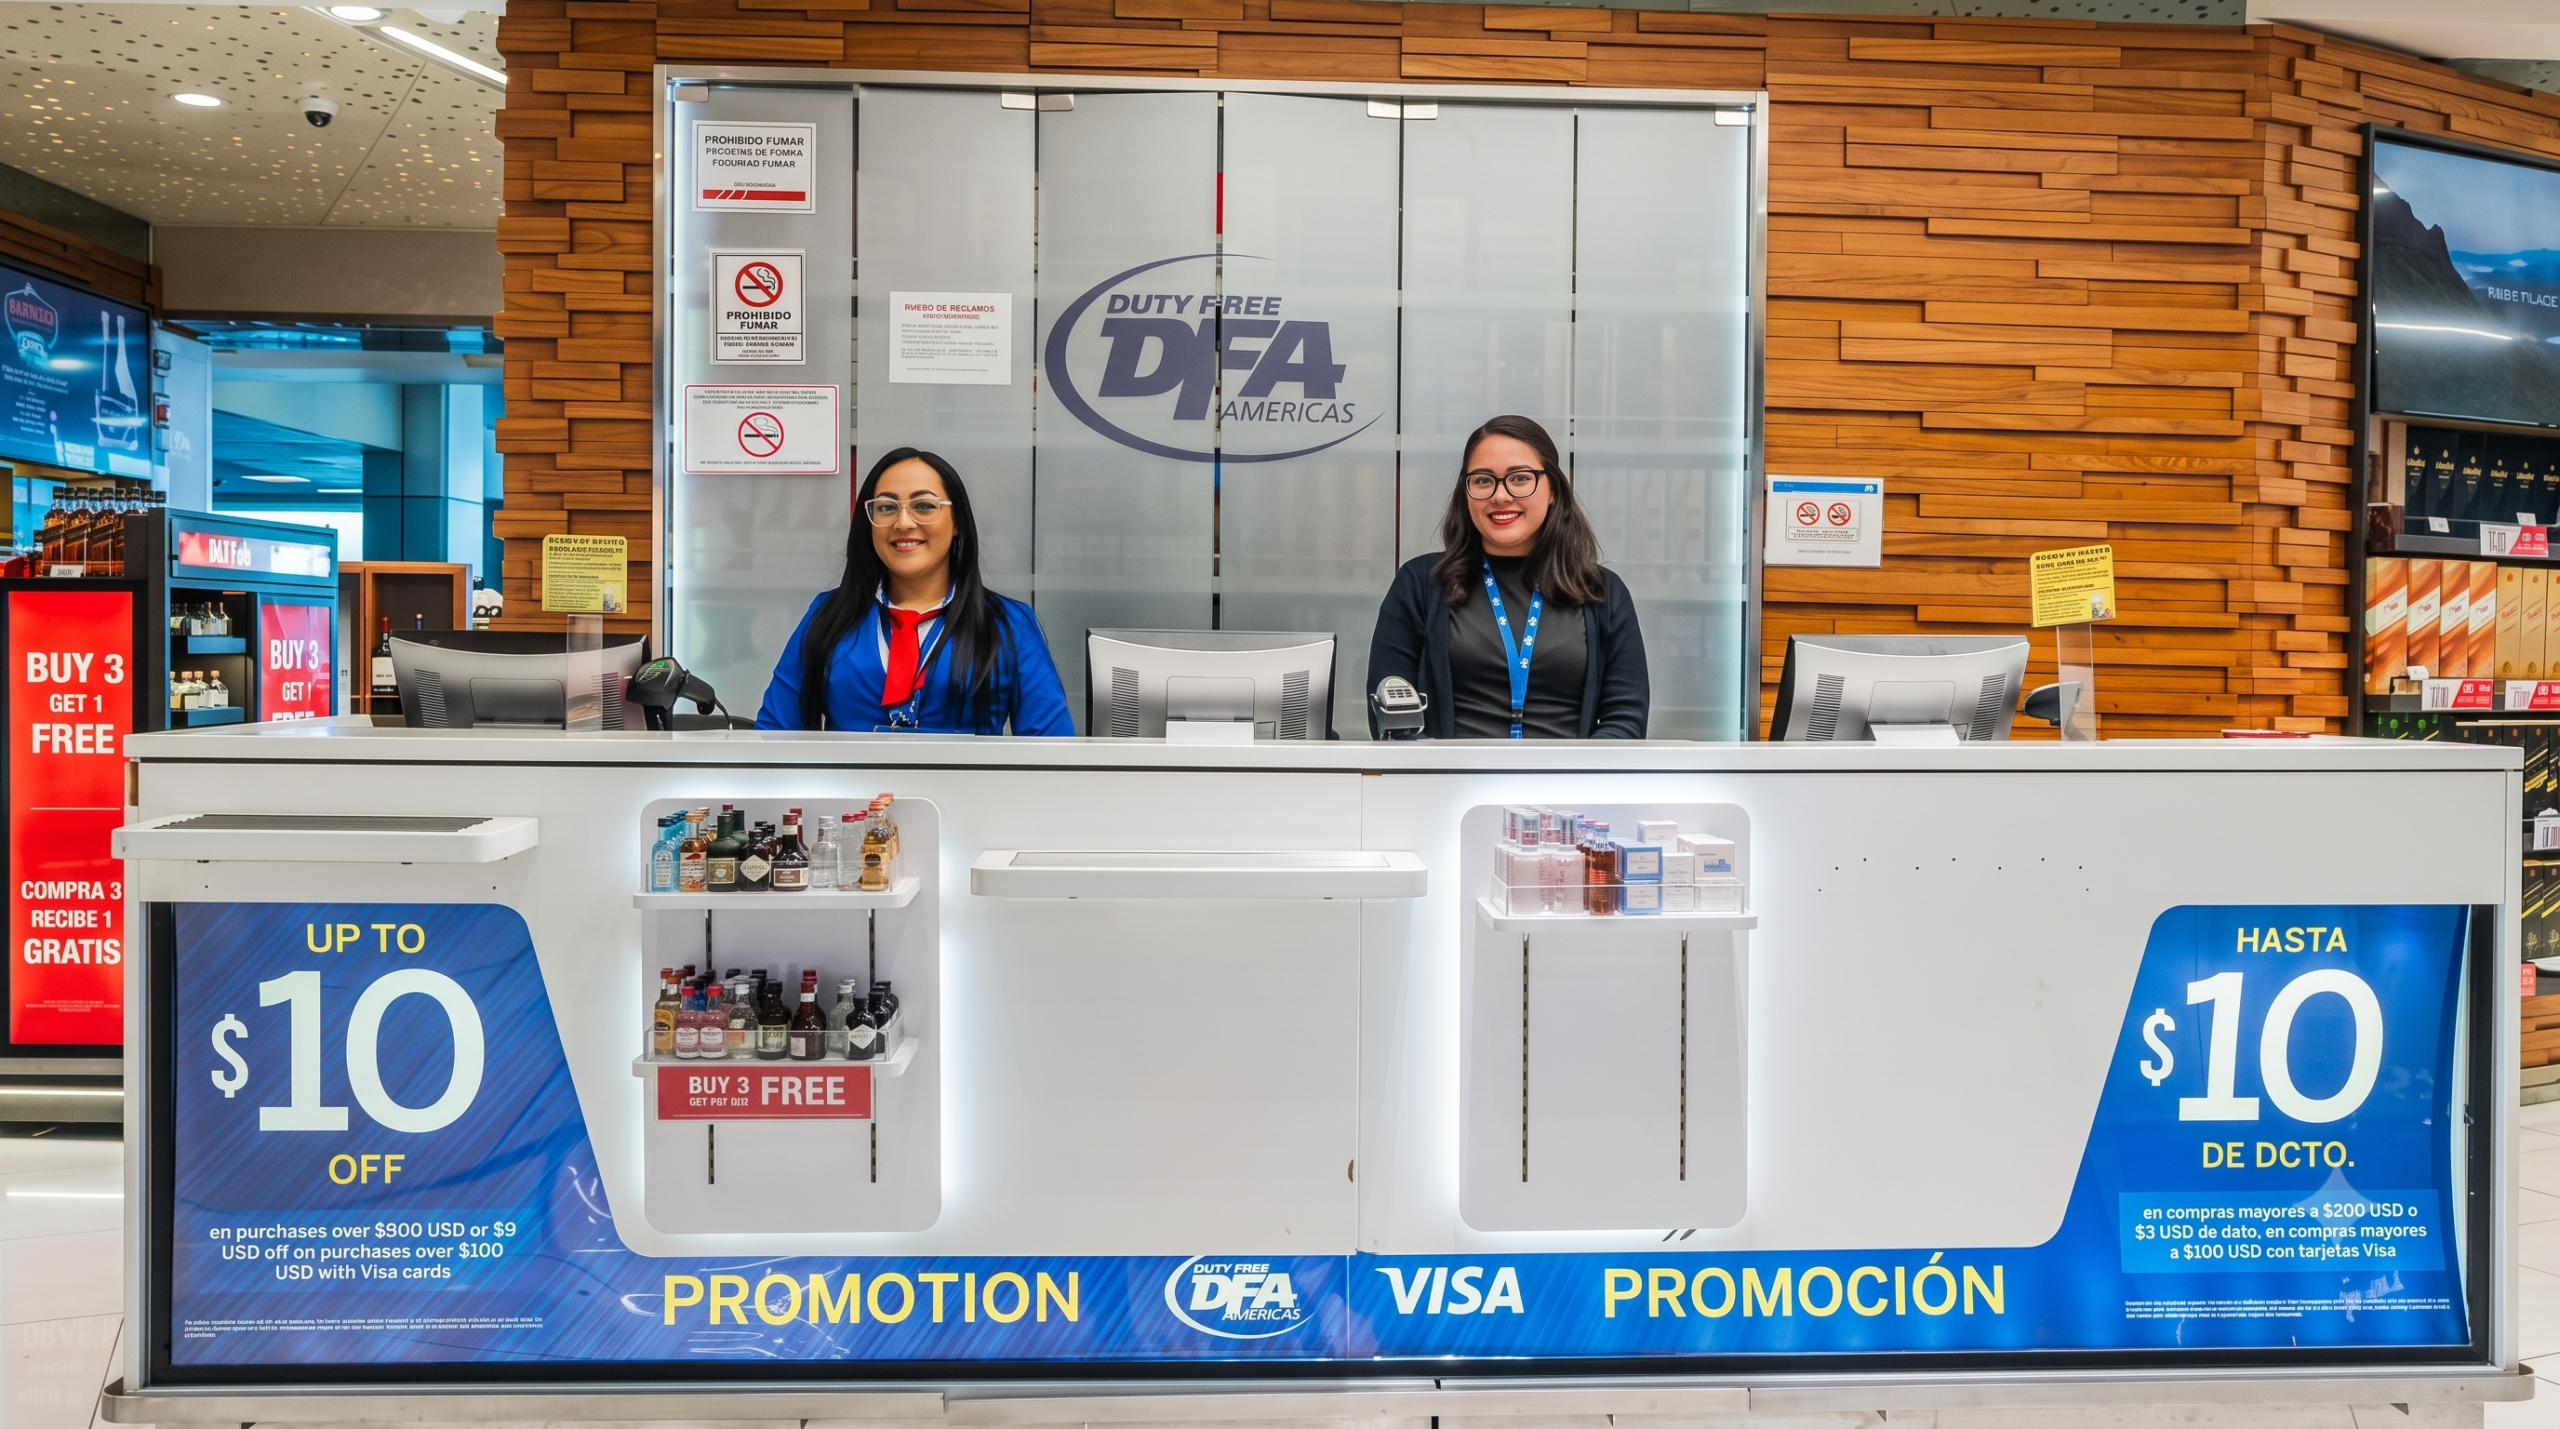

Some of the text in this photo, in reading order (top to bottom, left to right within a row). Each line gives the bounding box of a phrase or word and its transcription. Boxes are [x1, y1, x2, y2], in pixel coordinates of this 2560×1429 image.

[705, 136, 804, 146] PROHIBIDO FUMAR
[762, 160, 796, 168] FUMAR
[936, 304, 948, 312] DE
[950, 305, 995, 313] RECLAMOS
[1106, 294, 1283, 316] DUTY FREE
[726, 311, 791, 320] PROHIBIDO
[740, 321, 778, 330] FUMAR
[1098, 318, 1347, 421] DFA
[1219, 400, 1356, 423] AMERICAS
[270, 639, 319, 670] BUY 3
[27, 652, 124, 684] BUY 3
[282, 681, 304, 701] GET
[50, 693, 102, 713] GET 1
[32, 723, 115, 754] FREE
[21, 881, 122, 900] COMPRA 3
[31, 909, 112, 928] RECIBE 1
[306, 923, 426, 954] UP TO
[2236, 926, 2348, 953] HASTA
[23, 938, 121, 965] GRATIS
[689, 1076, 750, 1094] BUY 3
[761, 1076, 845, 1105] FREE
[689, 1097, 708, 1106] GET
[2202, 1140, 2355, 1168] DE DCTO.
[328, 1154, 405, 1185] OFF
[2143, 1202, 2418, 1222] en compras mayores a $200 USD o
[209, 1227, 231, 1239] en
[236, 1223, 328, 1242] purchases
[332, 1226, 370, 1238] over
[427, 1222, 465, 1237] USD
[470, 1225, 489, 1237] or
[493, 1221, 516, 1239] $9
[2135, 1223, 2427, 1241] $3 USD de dato, en compras mayores
[222, 1242, 504, 1262] USD off on purchases over $100
[2169, 1243, 2397, 1261] a $100 USD con tarjetas Visa
[275, 1263, 451, 1280] USD with Visa cards
[1193, 1263, 1270, 1274] DUTY FREE
[1189, 1273, 1298, 1314] DFA
[1374, 1266, 1525, 1315] VISA
[1604, 1251, 2005, 1318] PROMOCIÓN
[663, 1271, 1079, 1326] PROMOTION
[1221, 1308, 1302, 1321] AMERICAS
